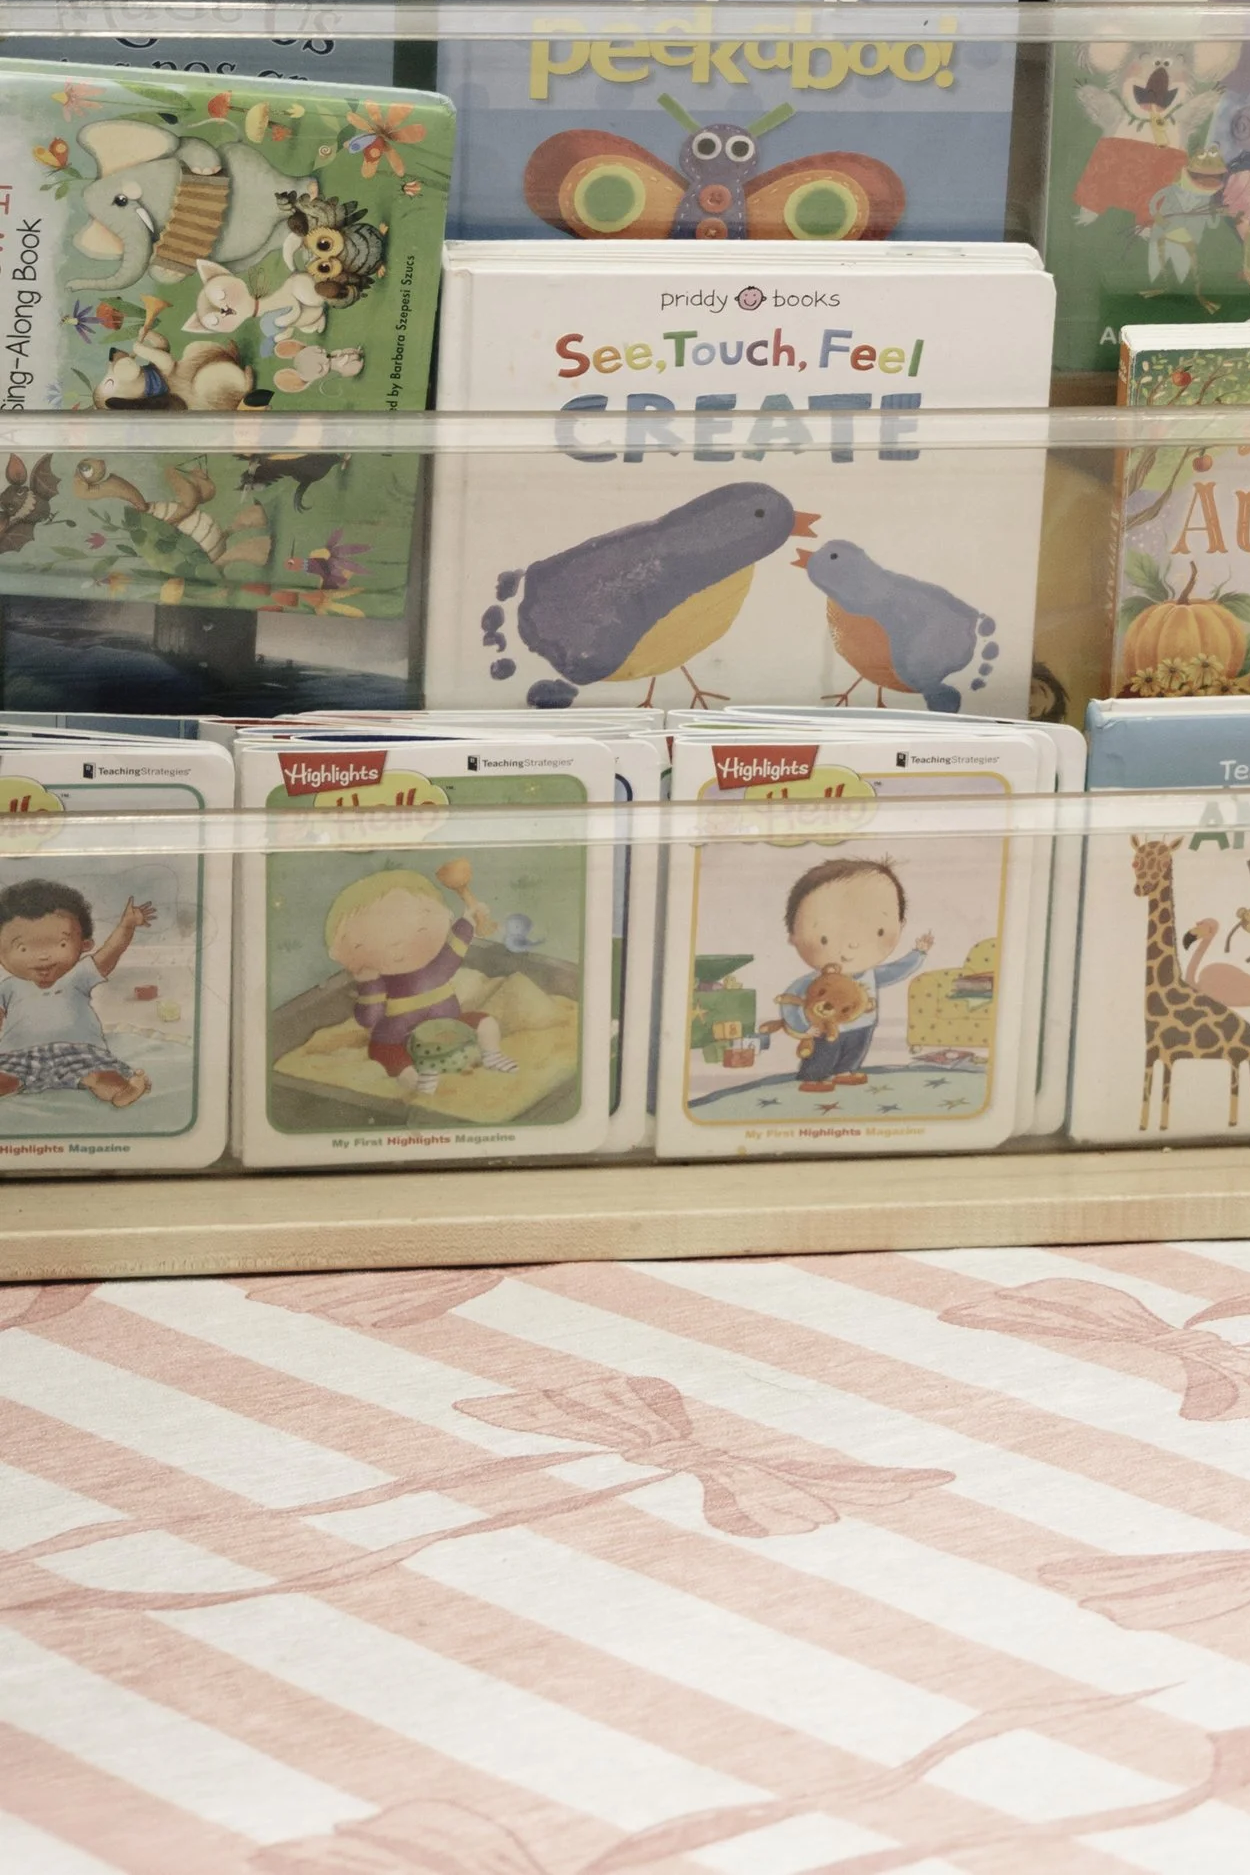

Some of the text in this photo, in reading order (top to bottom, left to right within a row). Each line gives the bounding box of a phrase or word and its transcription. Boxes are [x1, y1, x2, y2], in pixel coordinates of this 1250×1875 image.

[12, 218, 42, 281] Book
[401, 255, 415, 285] Szucs
[396, 289, 413, 331] Szepesi
[661, 289, 841, 313] priddy books
[390, 334, 406, 379] Barbara
[555, 328, 924, 379] See, Touch, Feel
[387, 385, 403, 397] by
[554, 391, 923, 464] CREATE
[284, 763, 379, 787] Highlights
[717, 757, 809, 781] Highlights
[332, 1132, 516, 1151] My First Highlights Magazine
[798, 1127, 861, 1139] Highlights
[68, 1141, 131, 1155] Magazine
